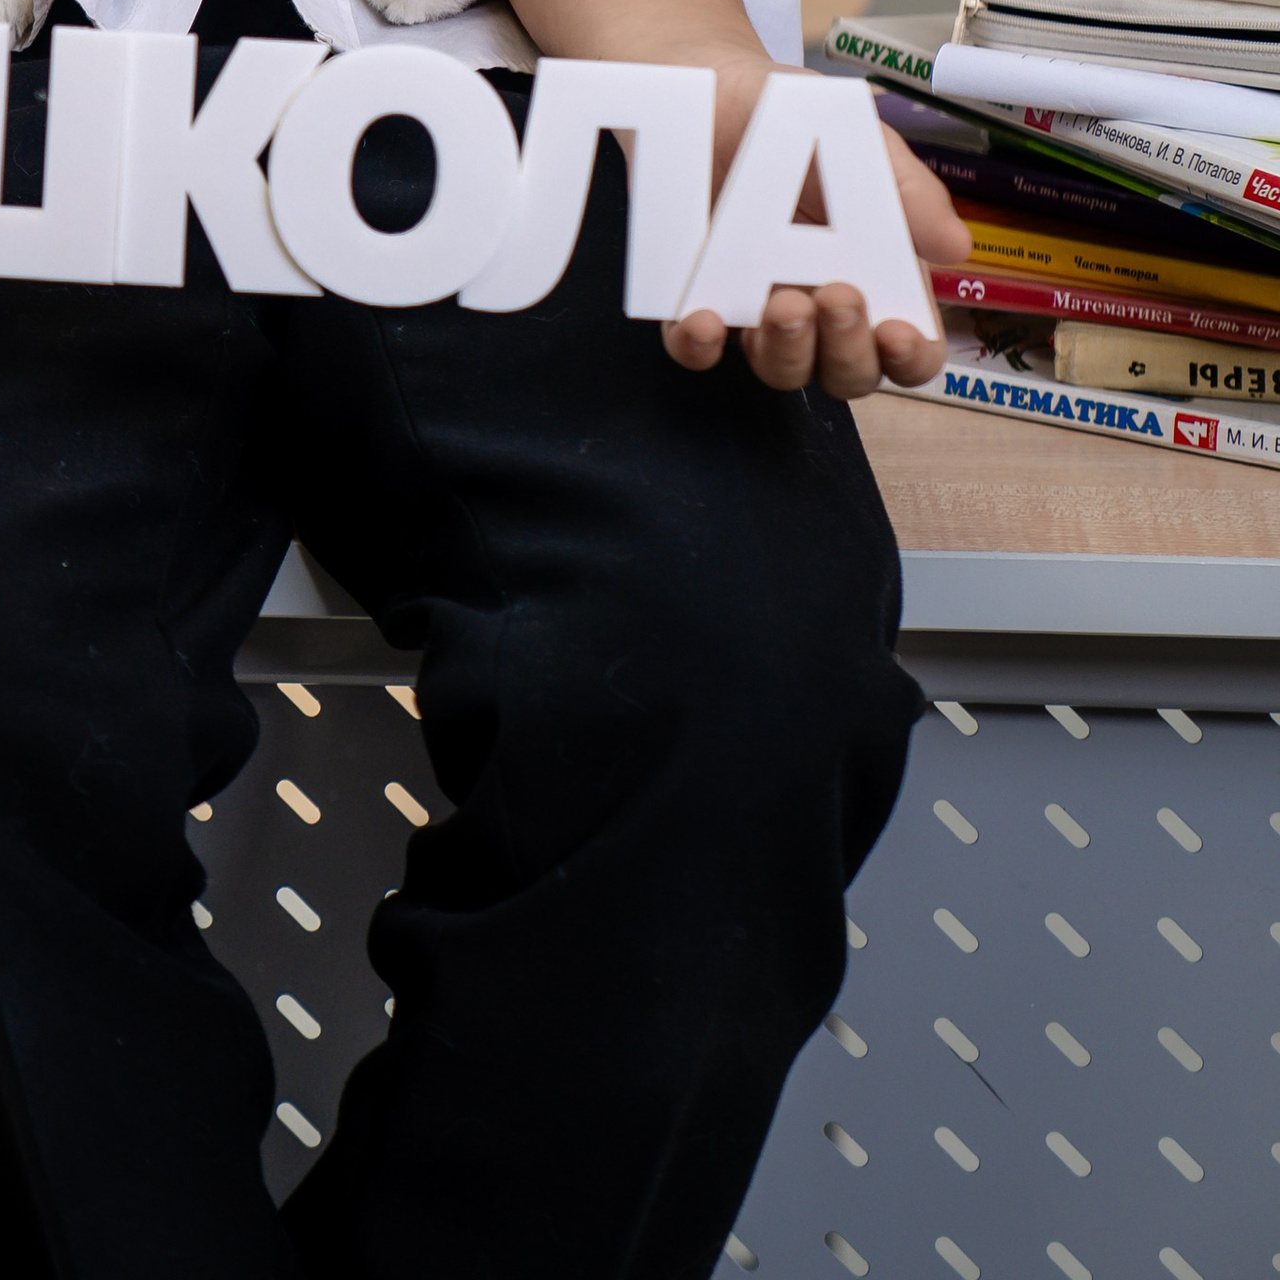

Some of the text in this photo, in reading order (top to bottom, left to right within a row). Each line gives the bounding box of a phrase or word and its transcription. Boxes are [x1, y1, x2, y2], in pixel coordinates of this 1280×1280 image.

[1086, 116, 1152, 158] Ивченкова,
[1156, 141, 1169, 161] И.
[1172, 147, 1184, 166] В.
[1187, 153, 1242, 185] Потапов
[1014, 175, 1117, 211] Часть вторая
[1028, 250, 1052, 265] мир
[1074, 255, 1160, 282] Часть вторая
[957, 278, 985, 301] 3
[1052, 289, 1174, 324] Математика
[1189, 311, 1240, 333] Часть
[944, 372, 1163, 437] МАТЕМАТИКА
[1177, 420, 1208, 447] 4
[1227, 427, 1246, 447] М.
[1252, 432, 1268, 451] И.
